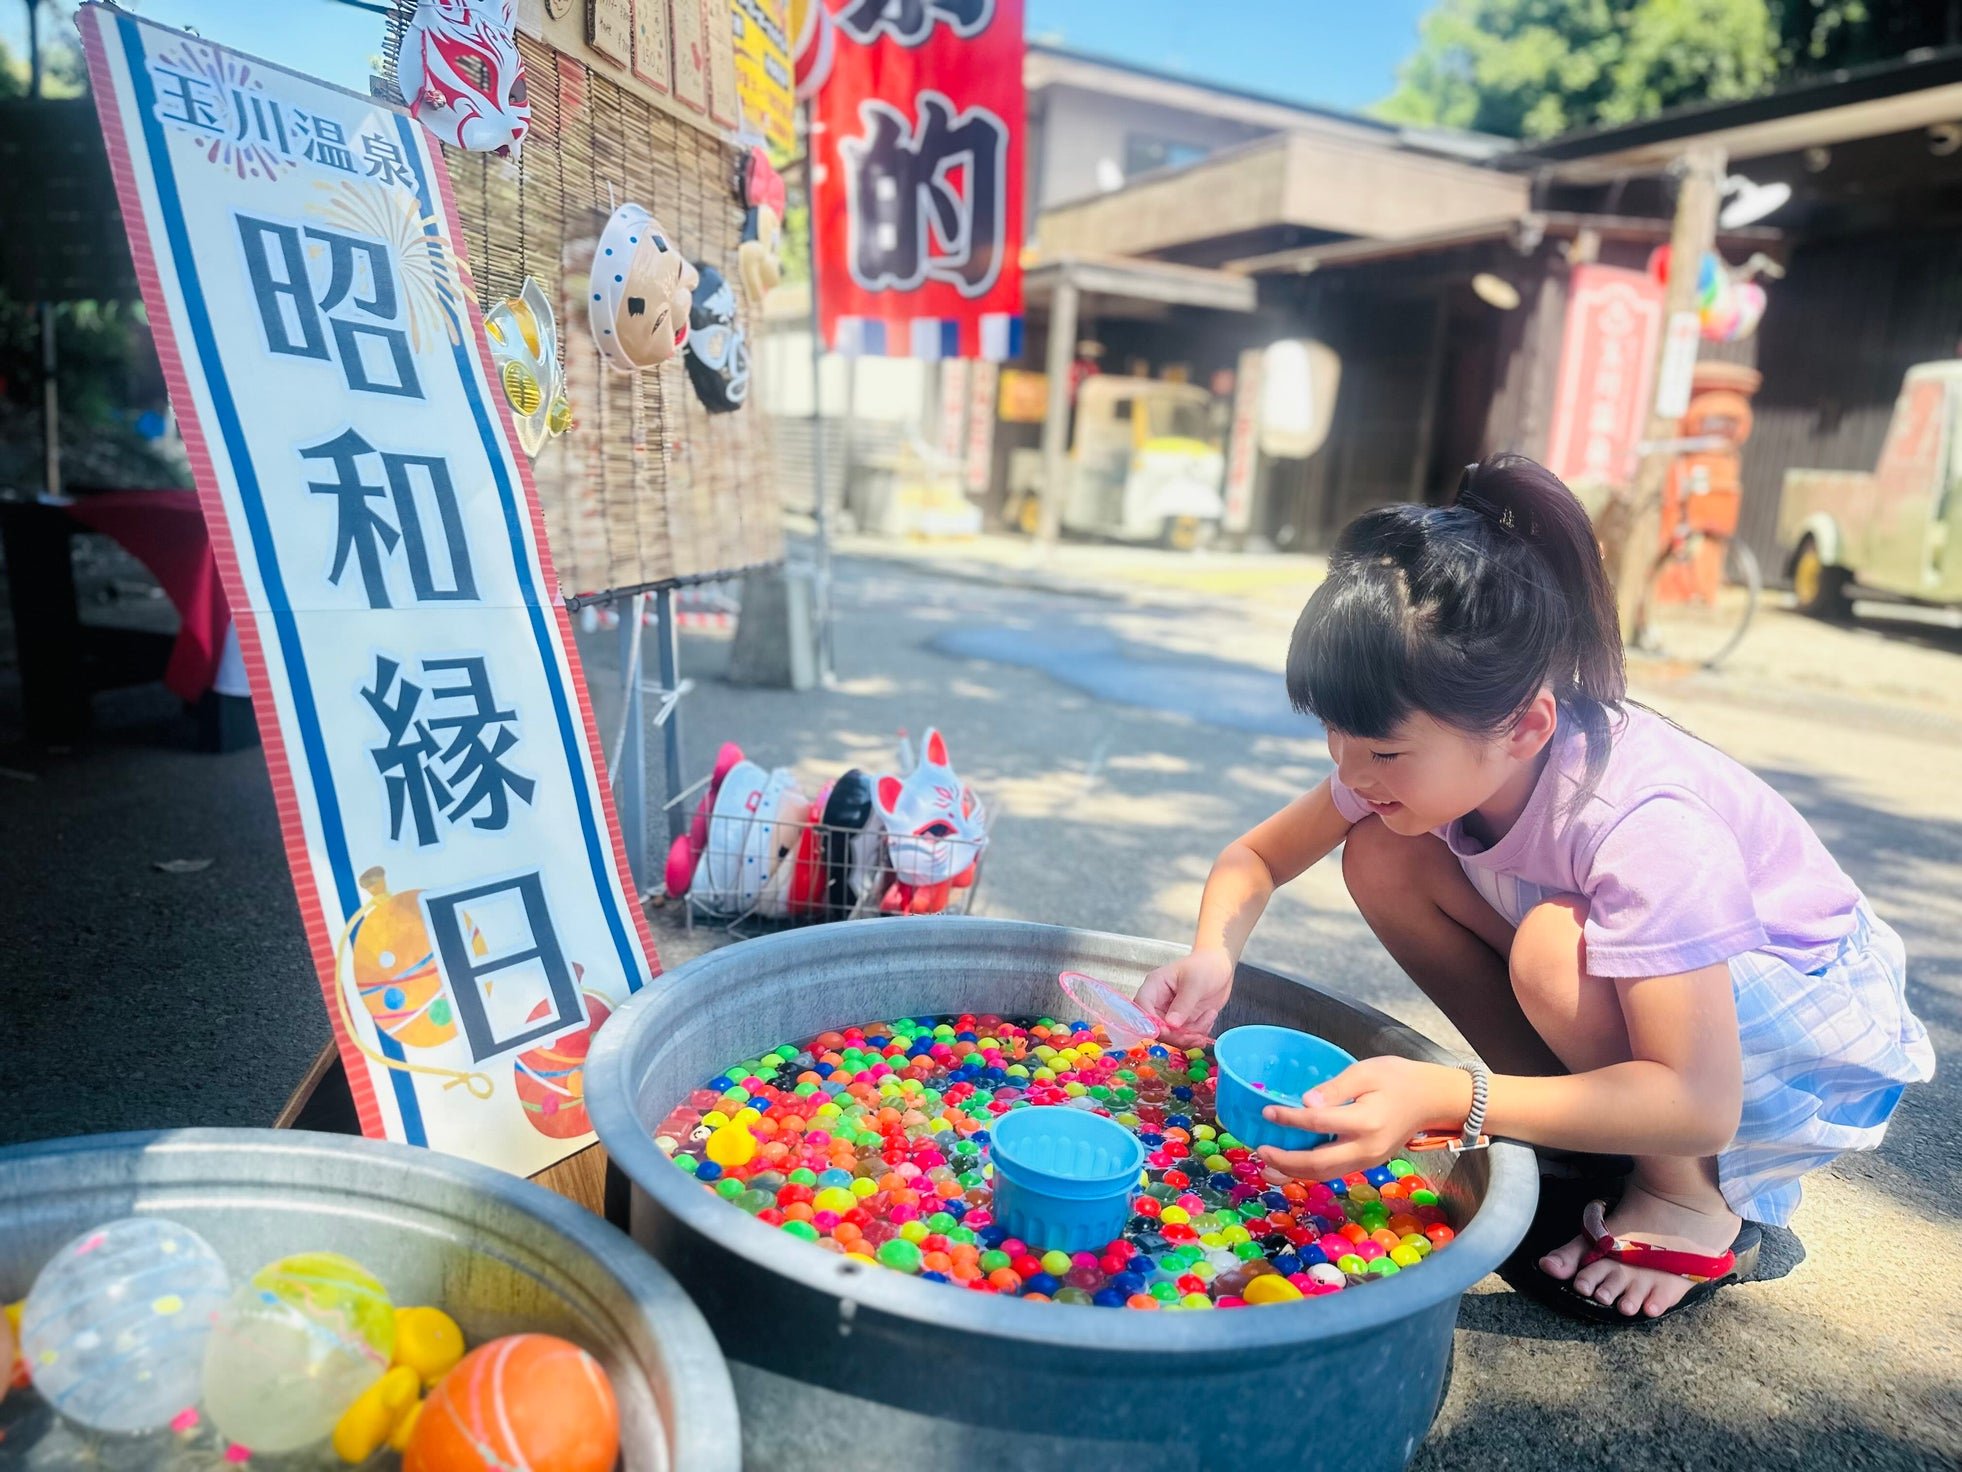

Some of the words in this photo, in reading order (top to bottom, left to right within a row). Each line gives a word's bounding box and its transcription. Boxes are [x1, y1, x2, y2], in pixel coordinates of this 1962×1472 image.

[153, 66, 417, 190] 玉川温泉
[235, 213, 585, 1064] 昭和縁日
